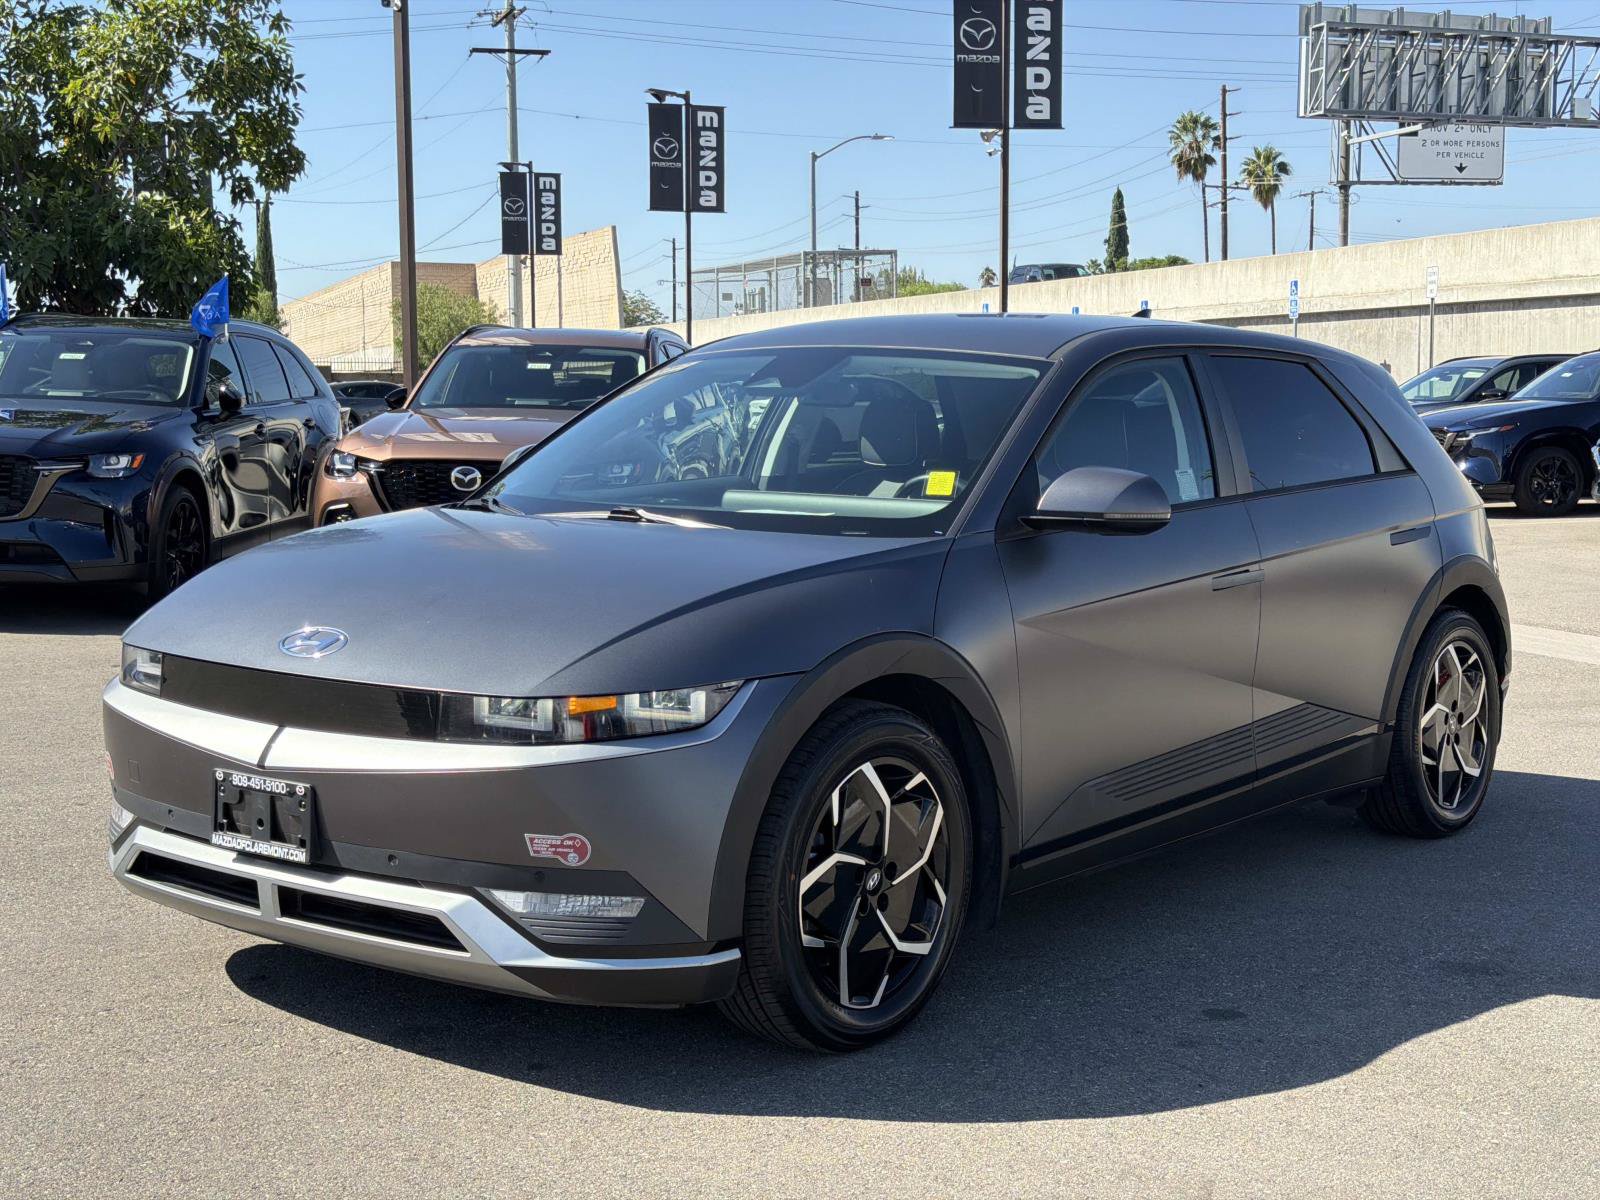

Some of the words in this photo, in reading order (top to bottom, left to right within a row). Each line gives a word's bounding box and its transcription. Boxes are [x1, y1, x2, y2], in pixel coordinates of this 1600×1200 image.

[956, 54, 1000, 64] mazda
[1025, 0, 1054, 120] azda
[1421, 139, 1427, 147] 2
[1466, 140, 1500, 148] PERSONS
[651, 161, 682, 169] mazda
[697, 110, 719, 207] mazda
[1436, 151, 1451, 159] PER
[538, 176, 557, 251] mazda
[232, 774, 287, 794] 909-451-5100
[211, 833, 306, 863] MAZDAOFCLAREMONT.COM
